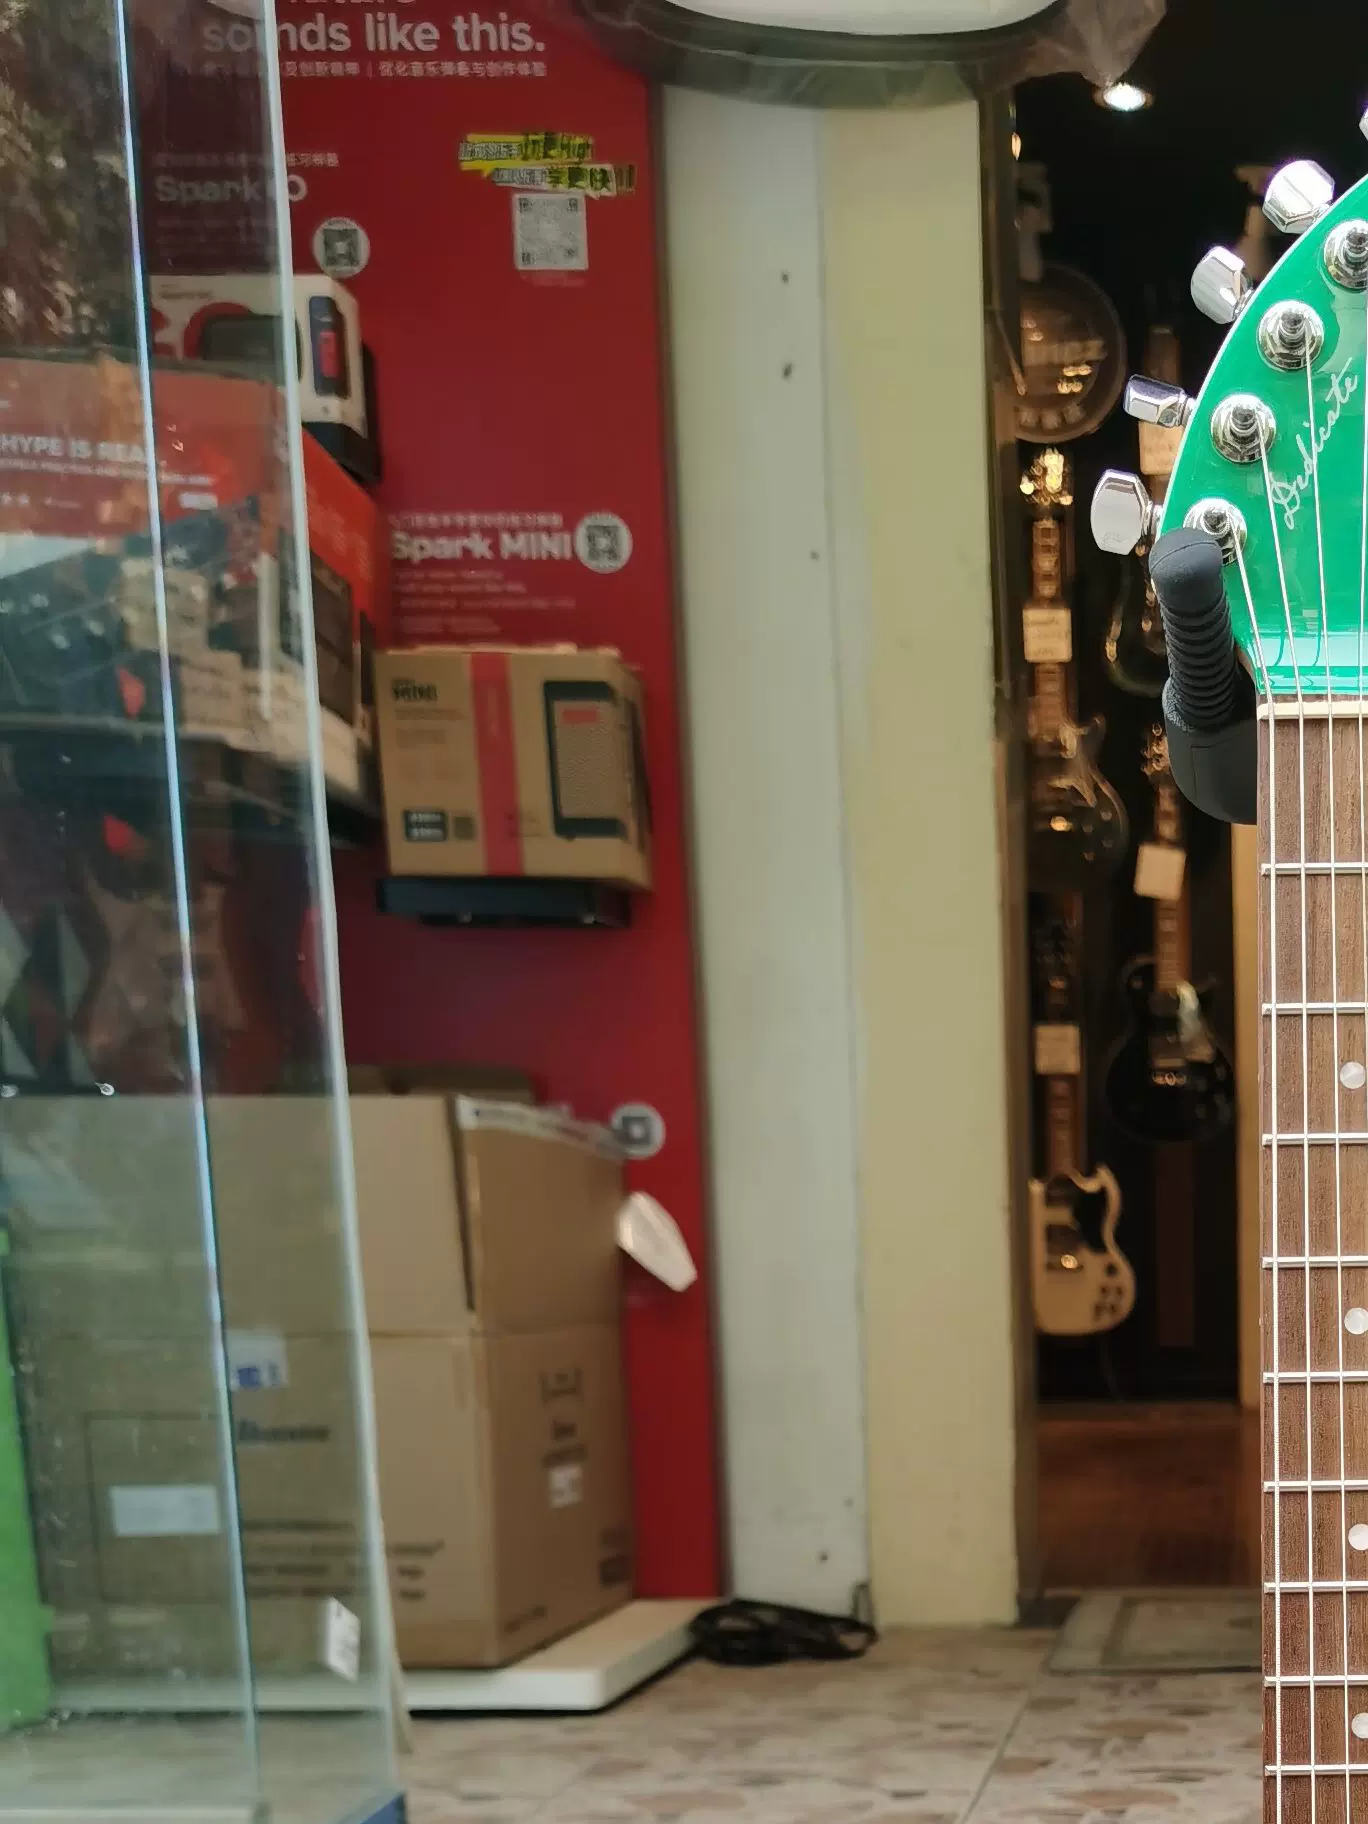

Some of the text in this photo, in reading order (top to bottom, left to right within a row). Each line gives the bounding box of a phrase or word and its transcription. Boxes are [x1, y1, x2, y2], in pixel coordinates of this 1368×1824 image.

[364, 12, 440, 51] like
[452, 13, 546, 51] this.
[1269, 357, 1358, 530] Dedicate
[391, 531, 573, 565] Spark MINI
